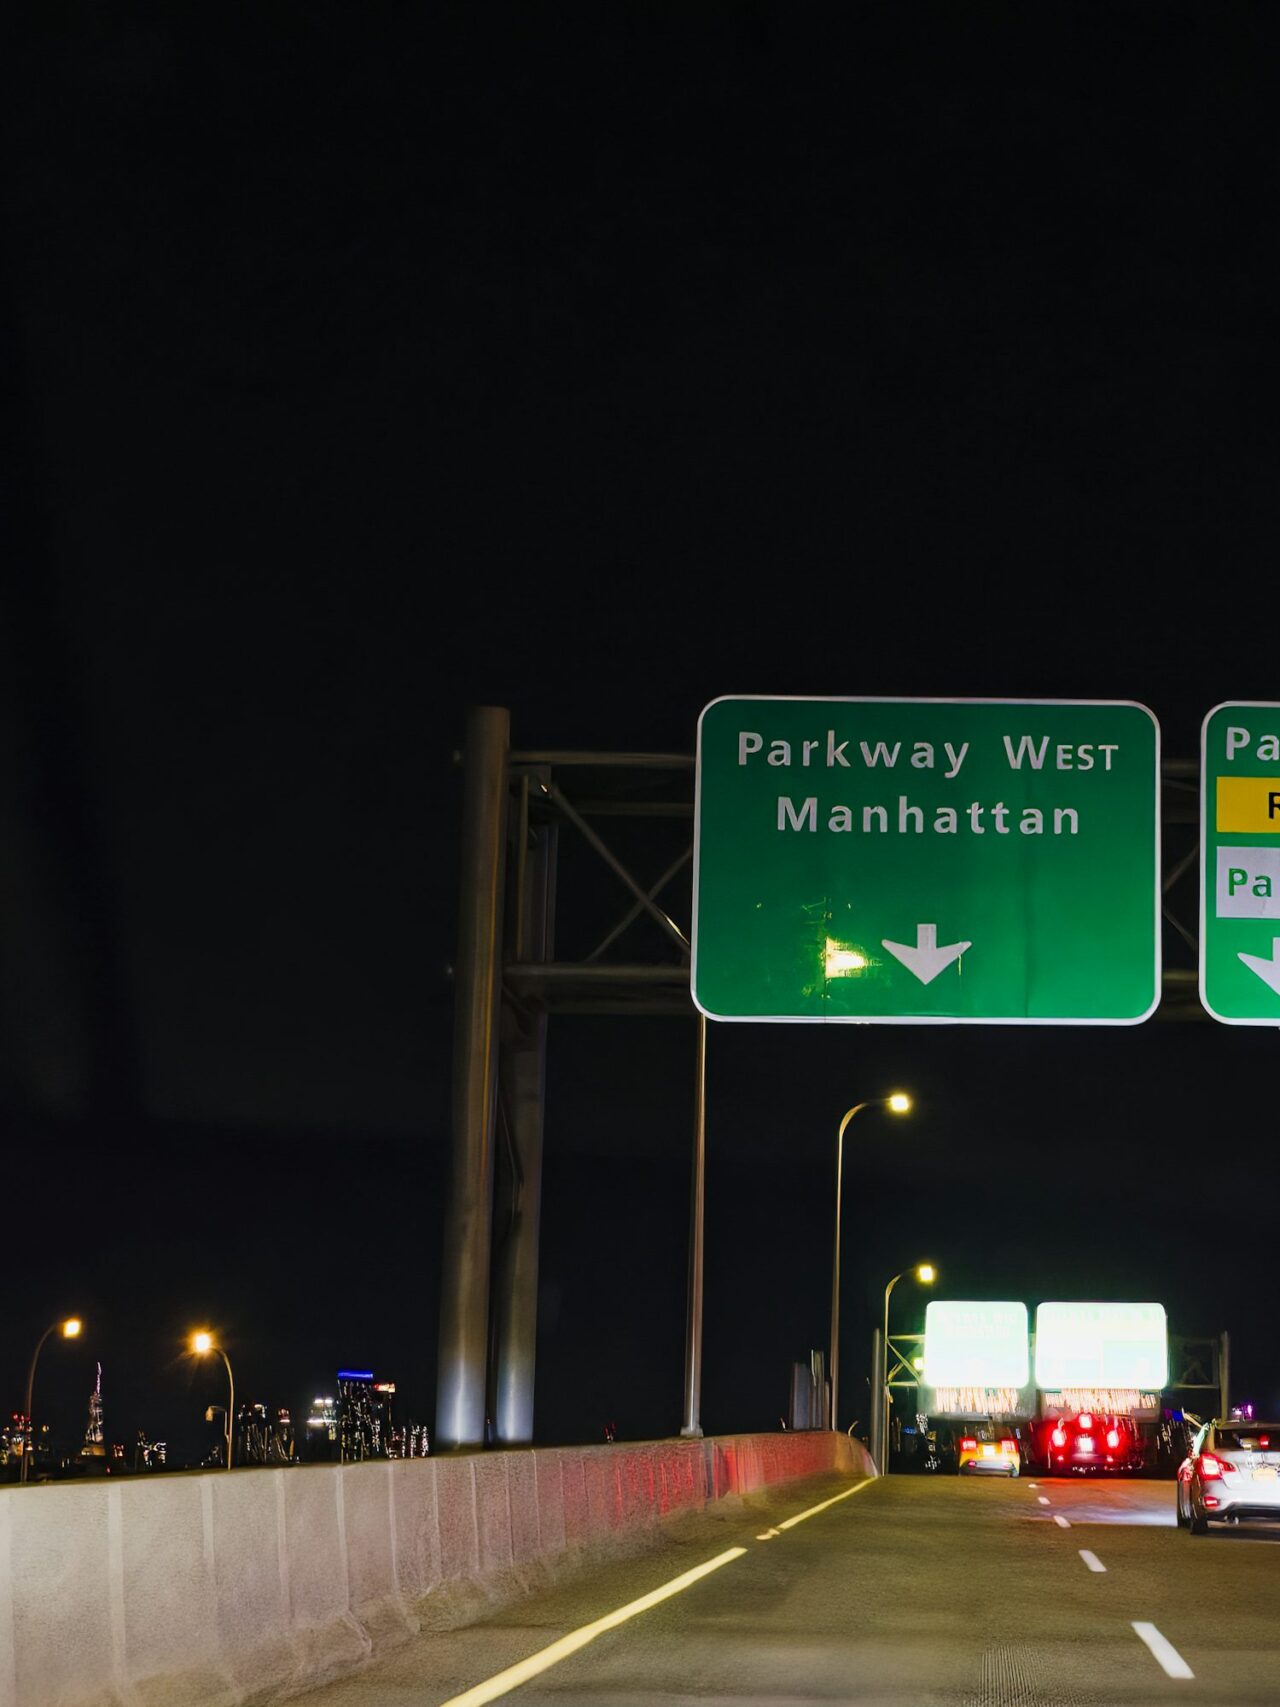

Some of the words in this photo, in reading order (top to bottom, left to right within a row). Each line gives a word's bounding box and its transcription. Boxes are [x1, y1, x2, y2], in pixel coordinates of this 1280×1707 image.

[738, 730, 970, 778] Parkway
[1003, 735, 1119, 771] WEST
[777, 796, 1080, 835] Manhattan
